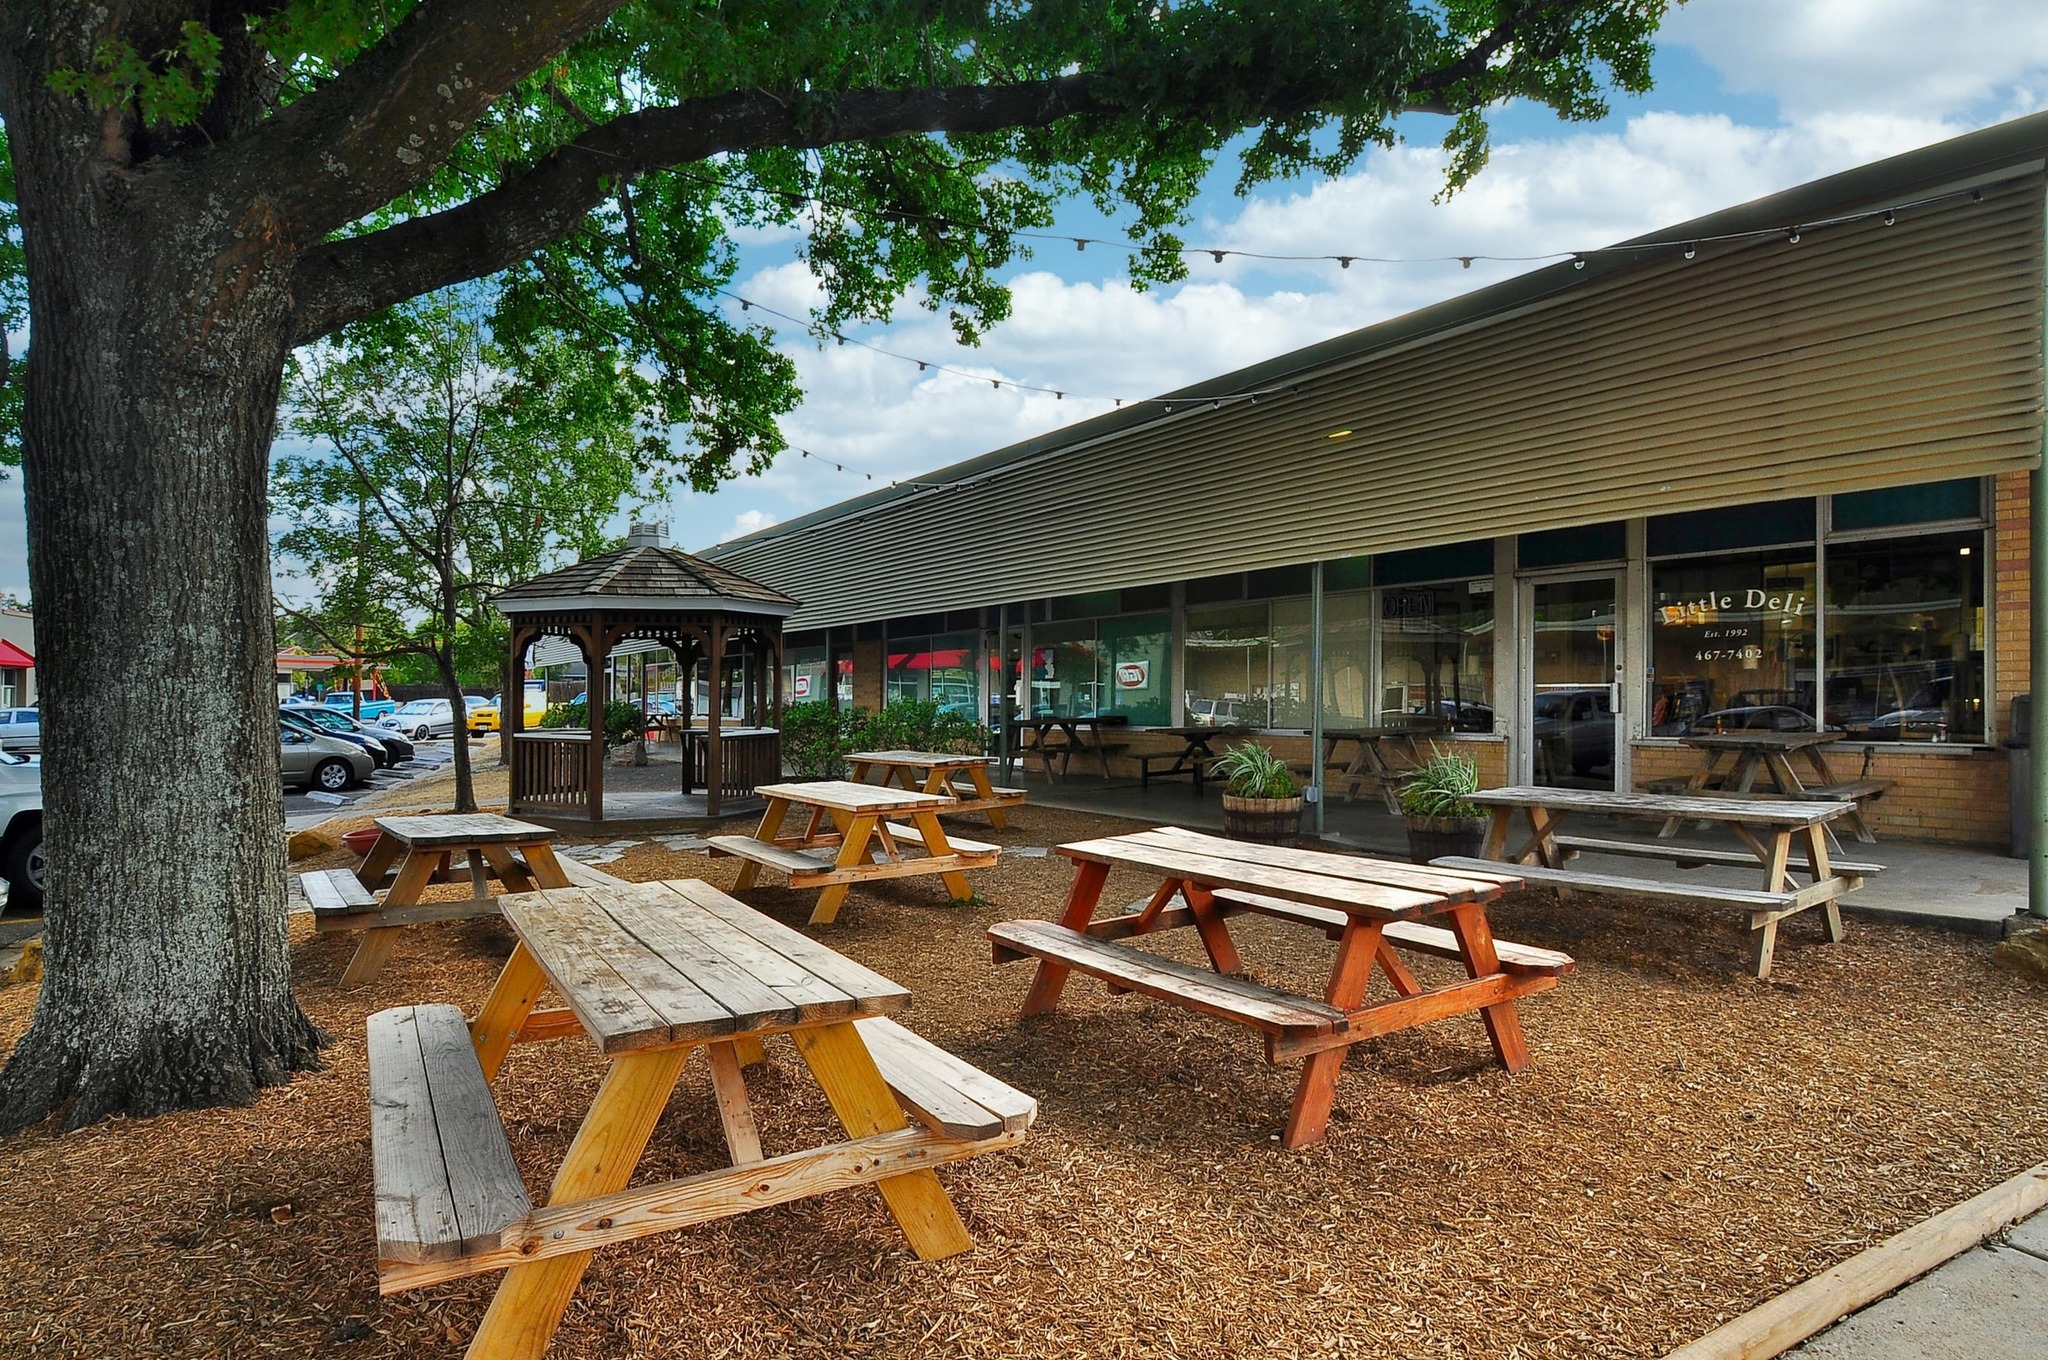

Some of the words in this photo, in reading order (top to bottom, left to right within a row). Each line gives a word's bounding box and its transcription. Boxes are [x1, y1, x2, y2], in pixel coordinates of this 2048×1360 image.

[1384, 594, 1431, 616] OPEN
[1659, 591, 1731, 624] Little
[1744, 589, 1805, 615] Deli
[1704, 630, 1721, 638] Est.
[1725, 628, 1748, 638] 1992
[1695, 649, 1762, 661] 467-7402
